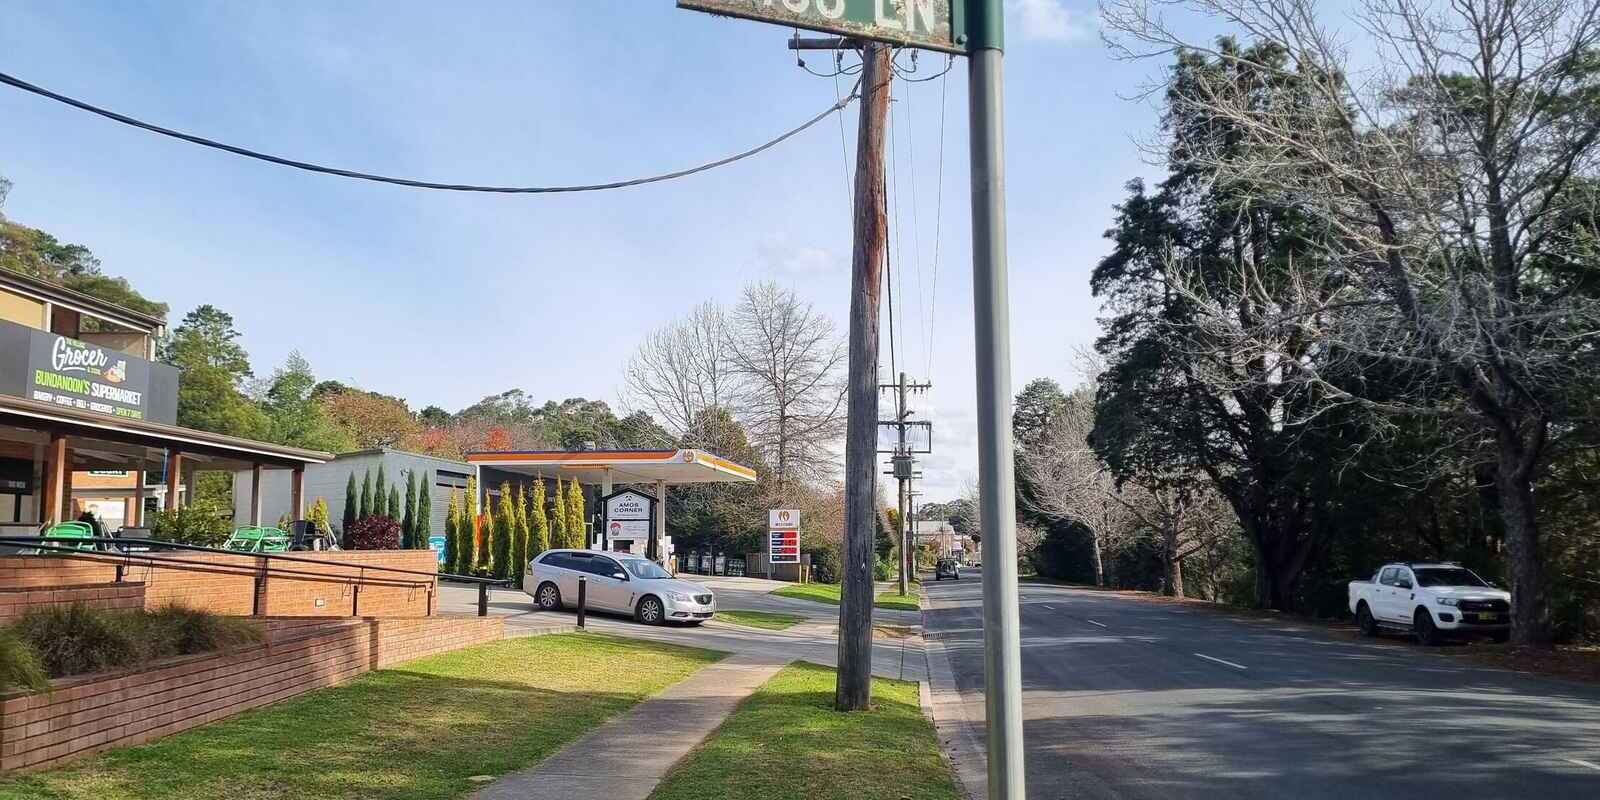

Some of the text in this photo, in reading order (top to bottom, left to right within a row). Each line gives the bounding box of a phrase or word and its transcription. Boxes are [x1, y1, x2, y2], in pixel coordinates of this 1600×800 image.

[875, 0, 936, 33] LN
[52, 336, 108, 371] Grocer
[35, 369, 142, 405] BUNDANOON'S SUPERMARKET
